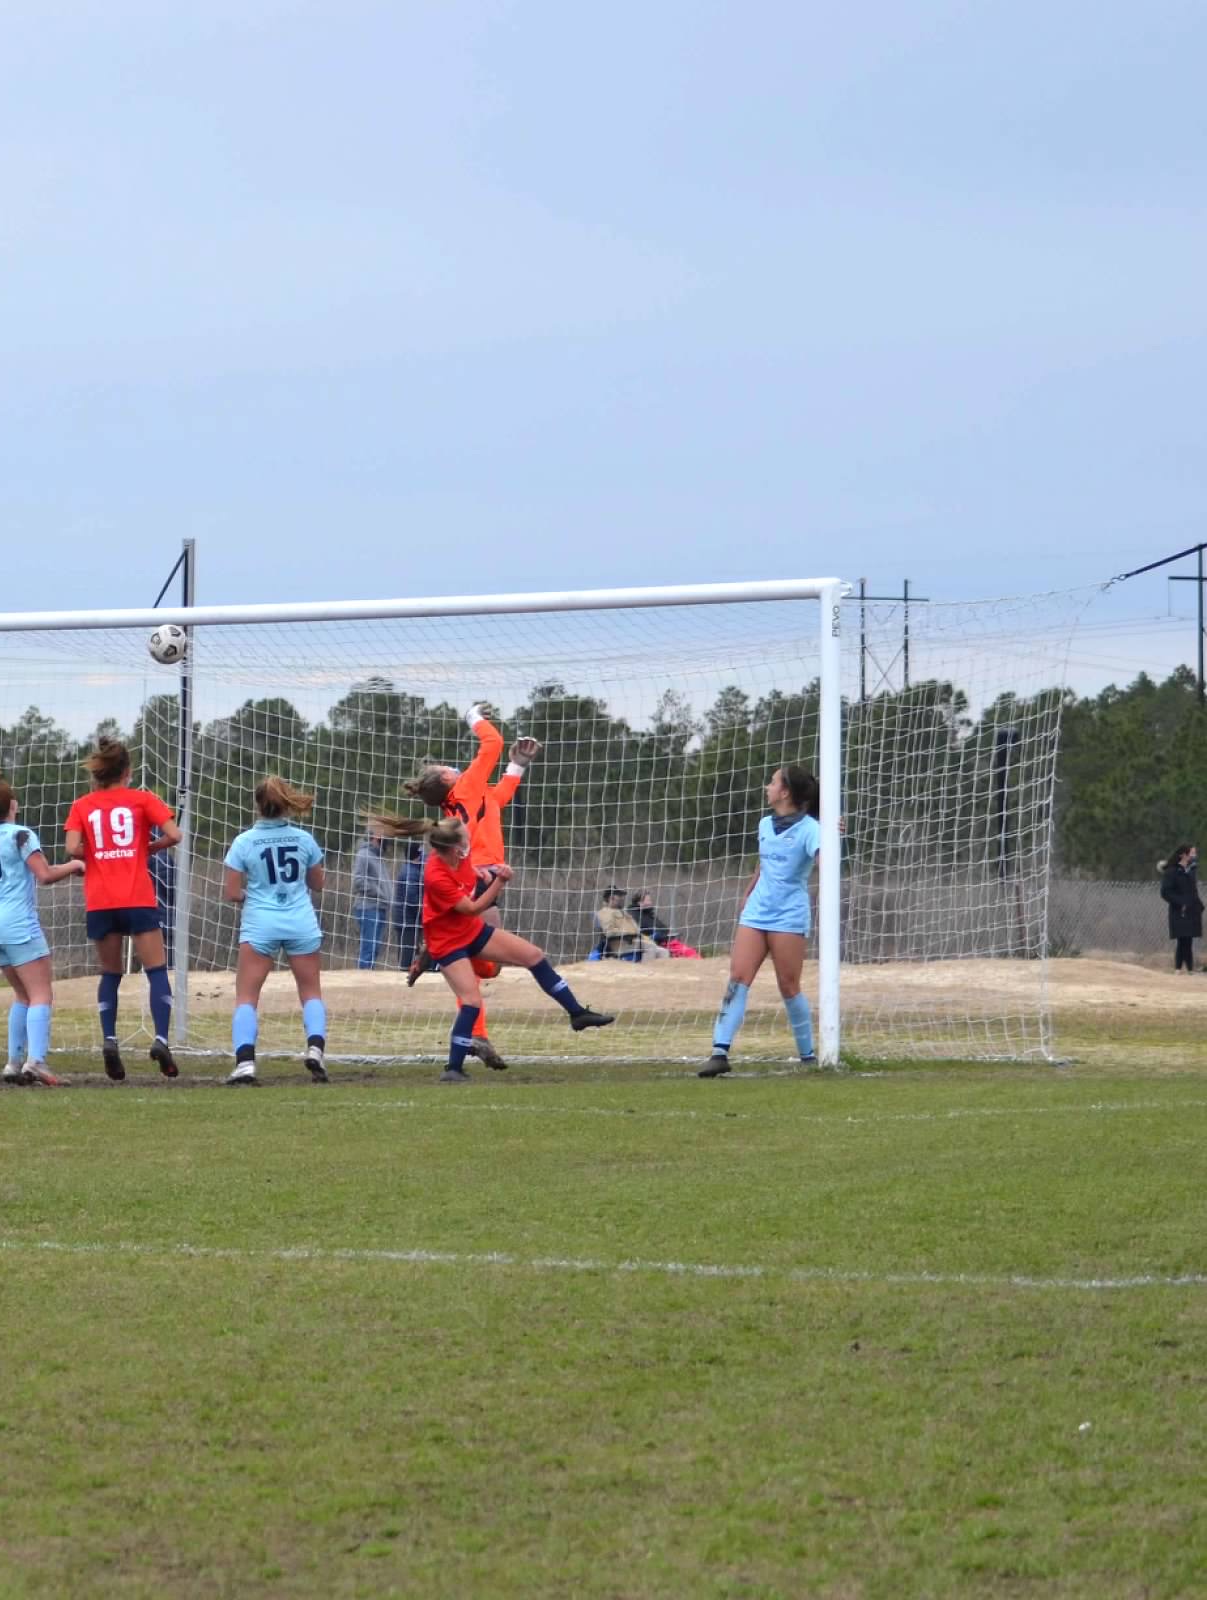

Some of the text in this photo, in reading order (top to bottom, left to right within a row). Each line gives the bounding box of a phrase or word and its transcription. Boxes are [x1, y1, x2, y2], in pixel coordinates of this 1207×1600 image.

[88, 807, 134, 849] 19
[104, 848, 135, 860] aetna
[260, 846, 300, 885] 15
